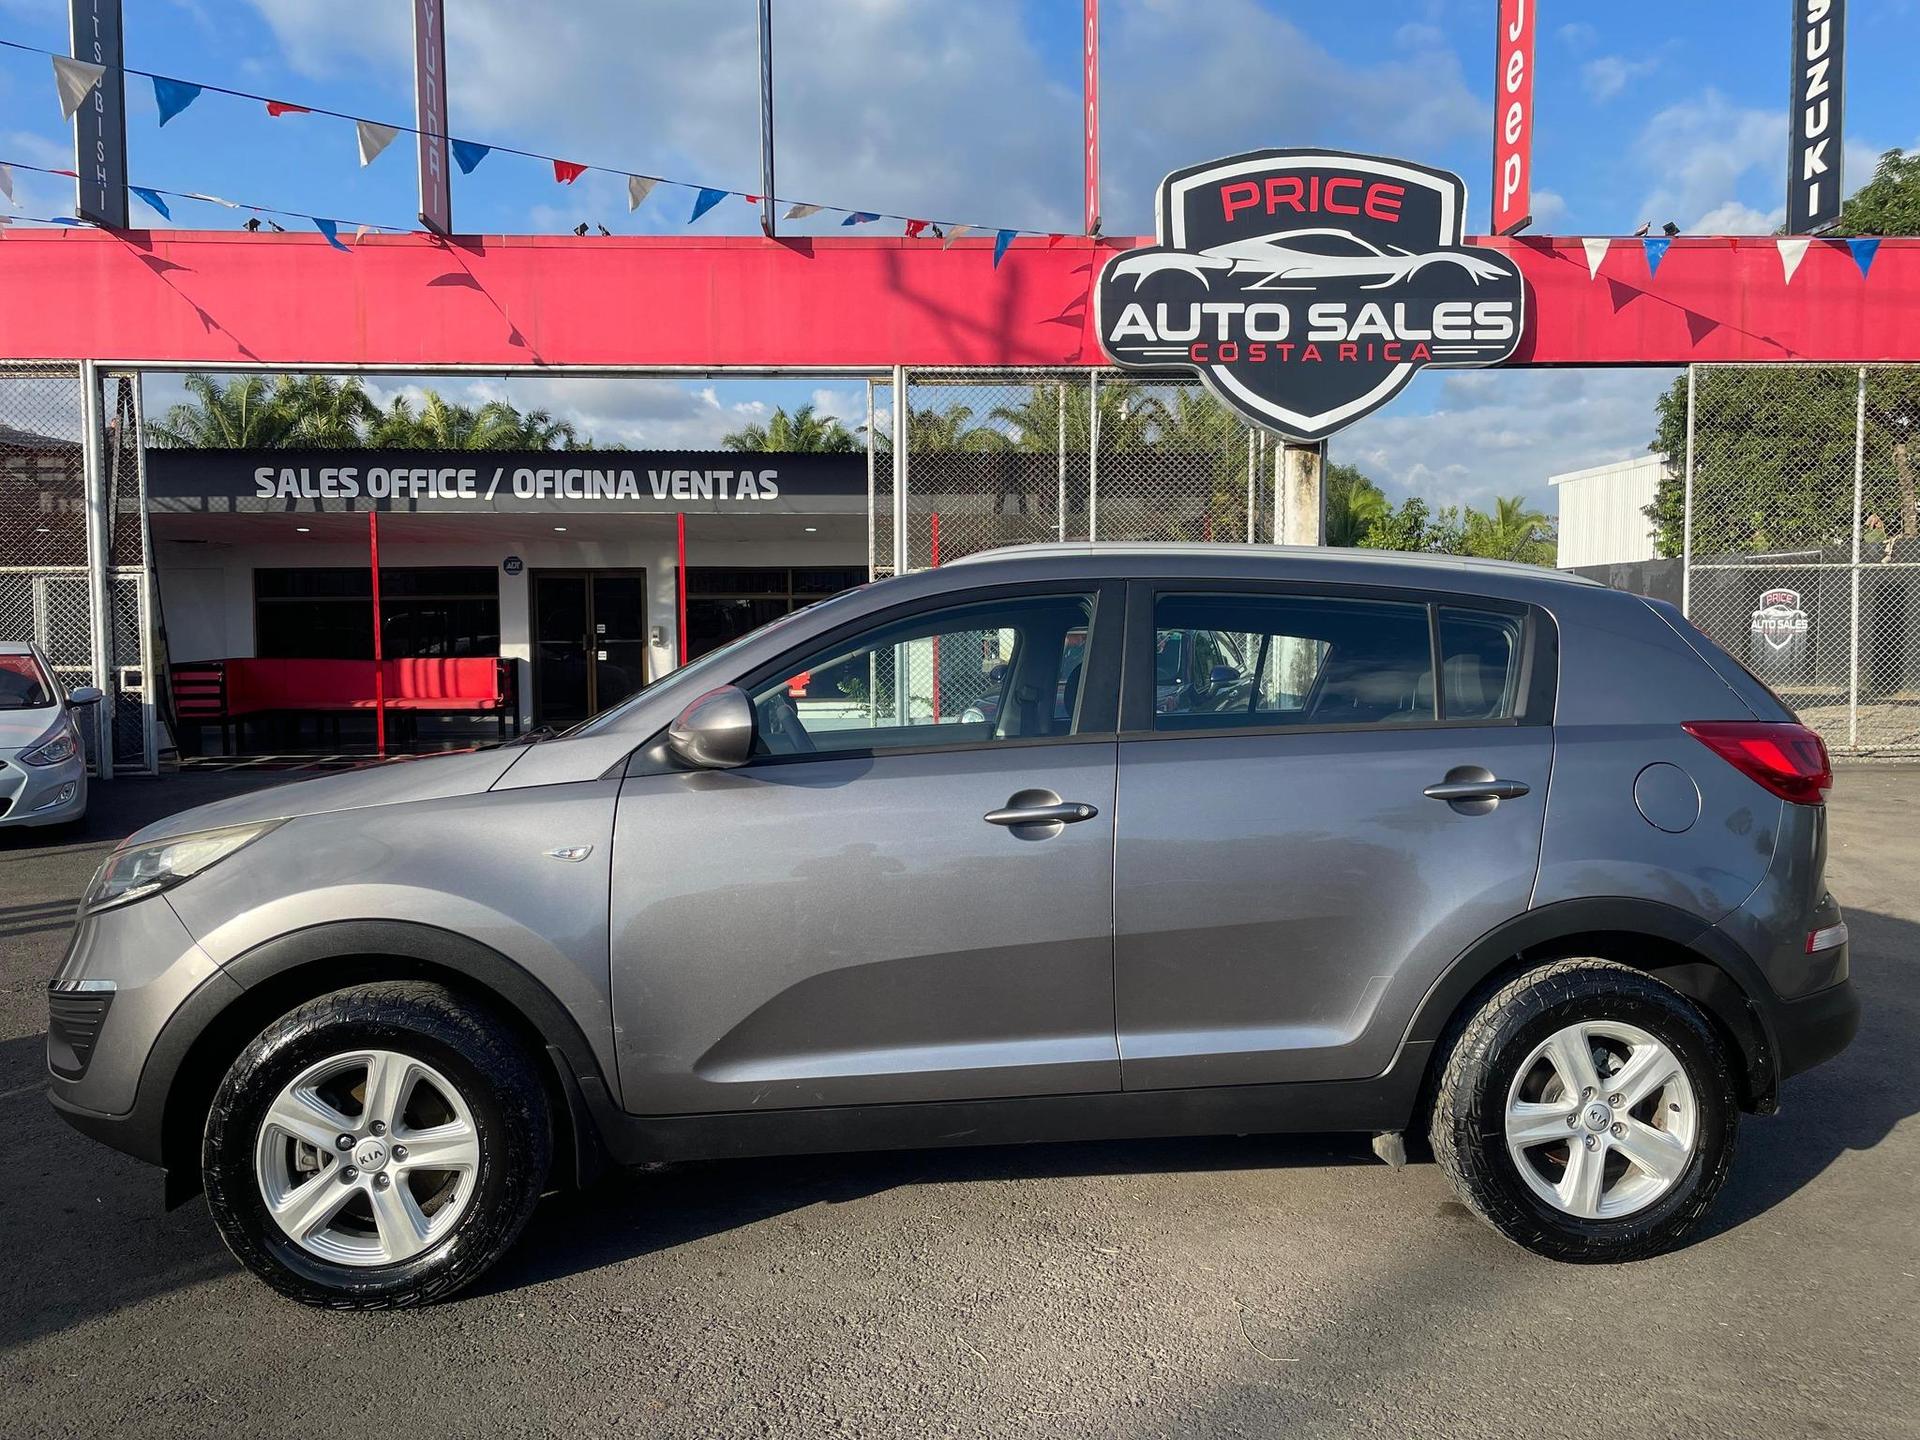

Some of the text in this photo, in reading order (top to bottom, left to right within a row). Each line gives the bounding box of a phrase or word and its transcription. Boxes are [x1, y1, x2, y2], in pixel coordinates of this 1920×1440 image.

[424, 0, 440, 215] YUNDAI
[1219, 176, 1406, 223] PRICE
[1109, 302, 1514, 342] AUTO SALES
[1189, 342, 1432, 362] COSTA RICA
[254, 467, 779, 501] SALES OFFICE / OFICINA VENTAS
[1766, 592, 1793, 606] PRICE
[1751, 619, 1808, 630] AUTO SALES
[1589, 1110, 1607, 1127] KIA
[359, 1150, 383, 1164] KIA
